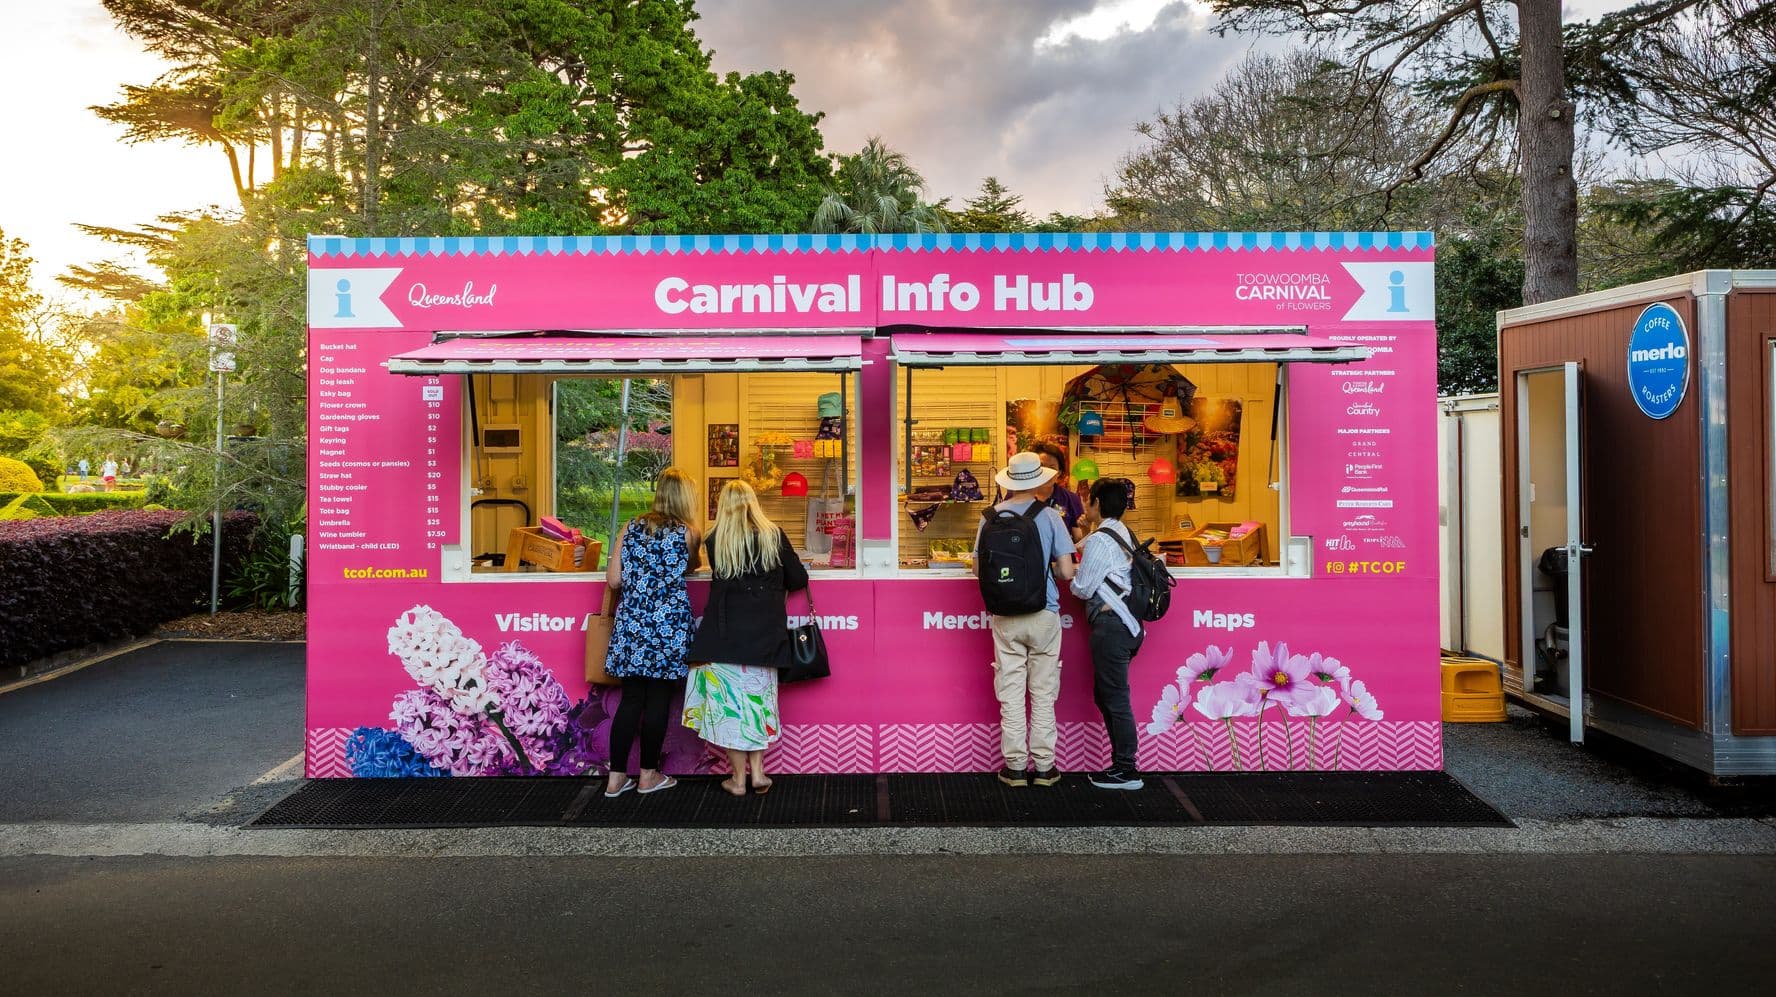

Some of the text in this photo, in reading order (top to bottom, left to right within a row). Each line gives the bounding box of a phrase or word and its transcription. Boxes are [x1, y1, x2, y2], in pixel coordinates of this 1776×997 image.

[1236, 273, 1331, 285] TOOWOOMBA
[408, 280, 497, 309] Queensland
[654, 273, 1095, 314] Carnival Info Hub
[1235, 285, 1331, 300] CARNIVAL
[1276, 302, 1331, 311] of FLOWERS
[1644, 317, 1671, 333] COFFEE
[1632, 342, 1685, 362] merlo
[1642, 383, 1676, 404] ROASTERS
[1346, 406, 1380, 417] Country
[320, 437, 347, 445] Keyring
[380, 543, 400, 551] (LED)
[343, 567, 428, 579] tcof.com.au
[1348, 561, 1406, 574] #TCOF
[494, 612, 576, 632] Visitor
[1193, 609, 1256, 631] Maps
